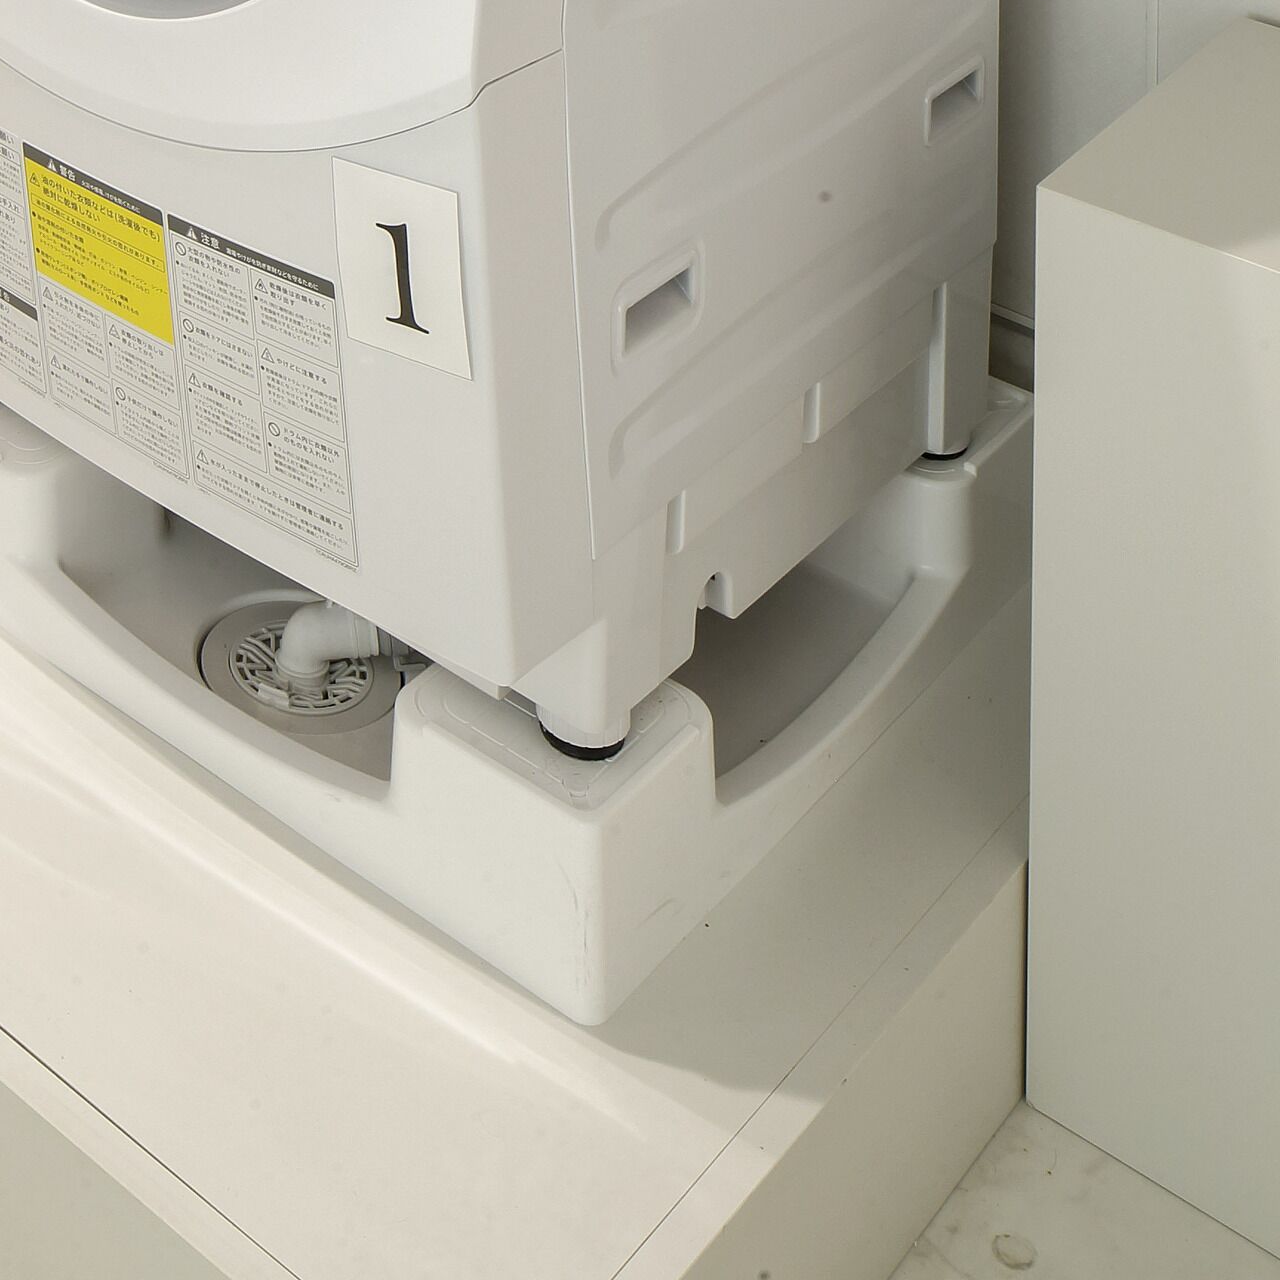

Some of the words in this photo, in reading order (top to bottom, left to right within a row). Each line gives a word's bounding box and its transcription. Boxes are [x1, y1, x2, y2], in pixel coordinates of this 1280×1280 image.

[59, 164, 76, 181] 警告
[42, 184, 101, 222] 絶対に乾燥しない
[201, 232, 220, 250] 注意
[375, 222, 430, 335] 1
[277, 357, 327, 385] やけどに注意する
